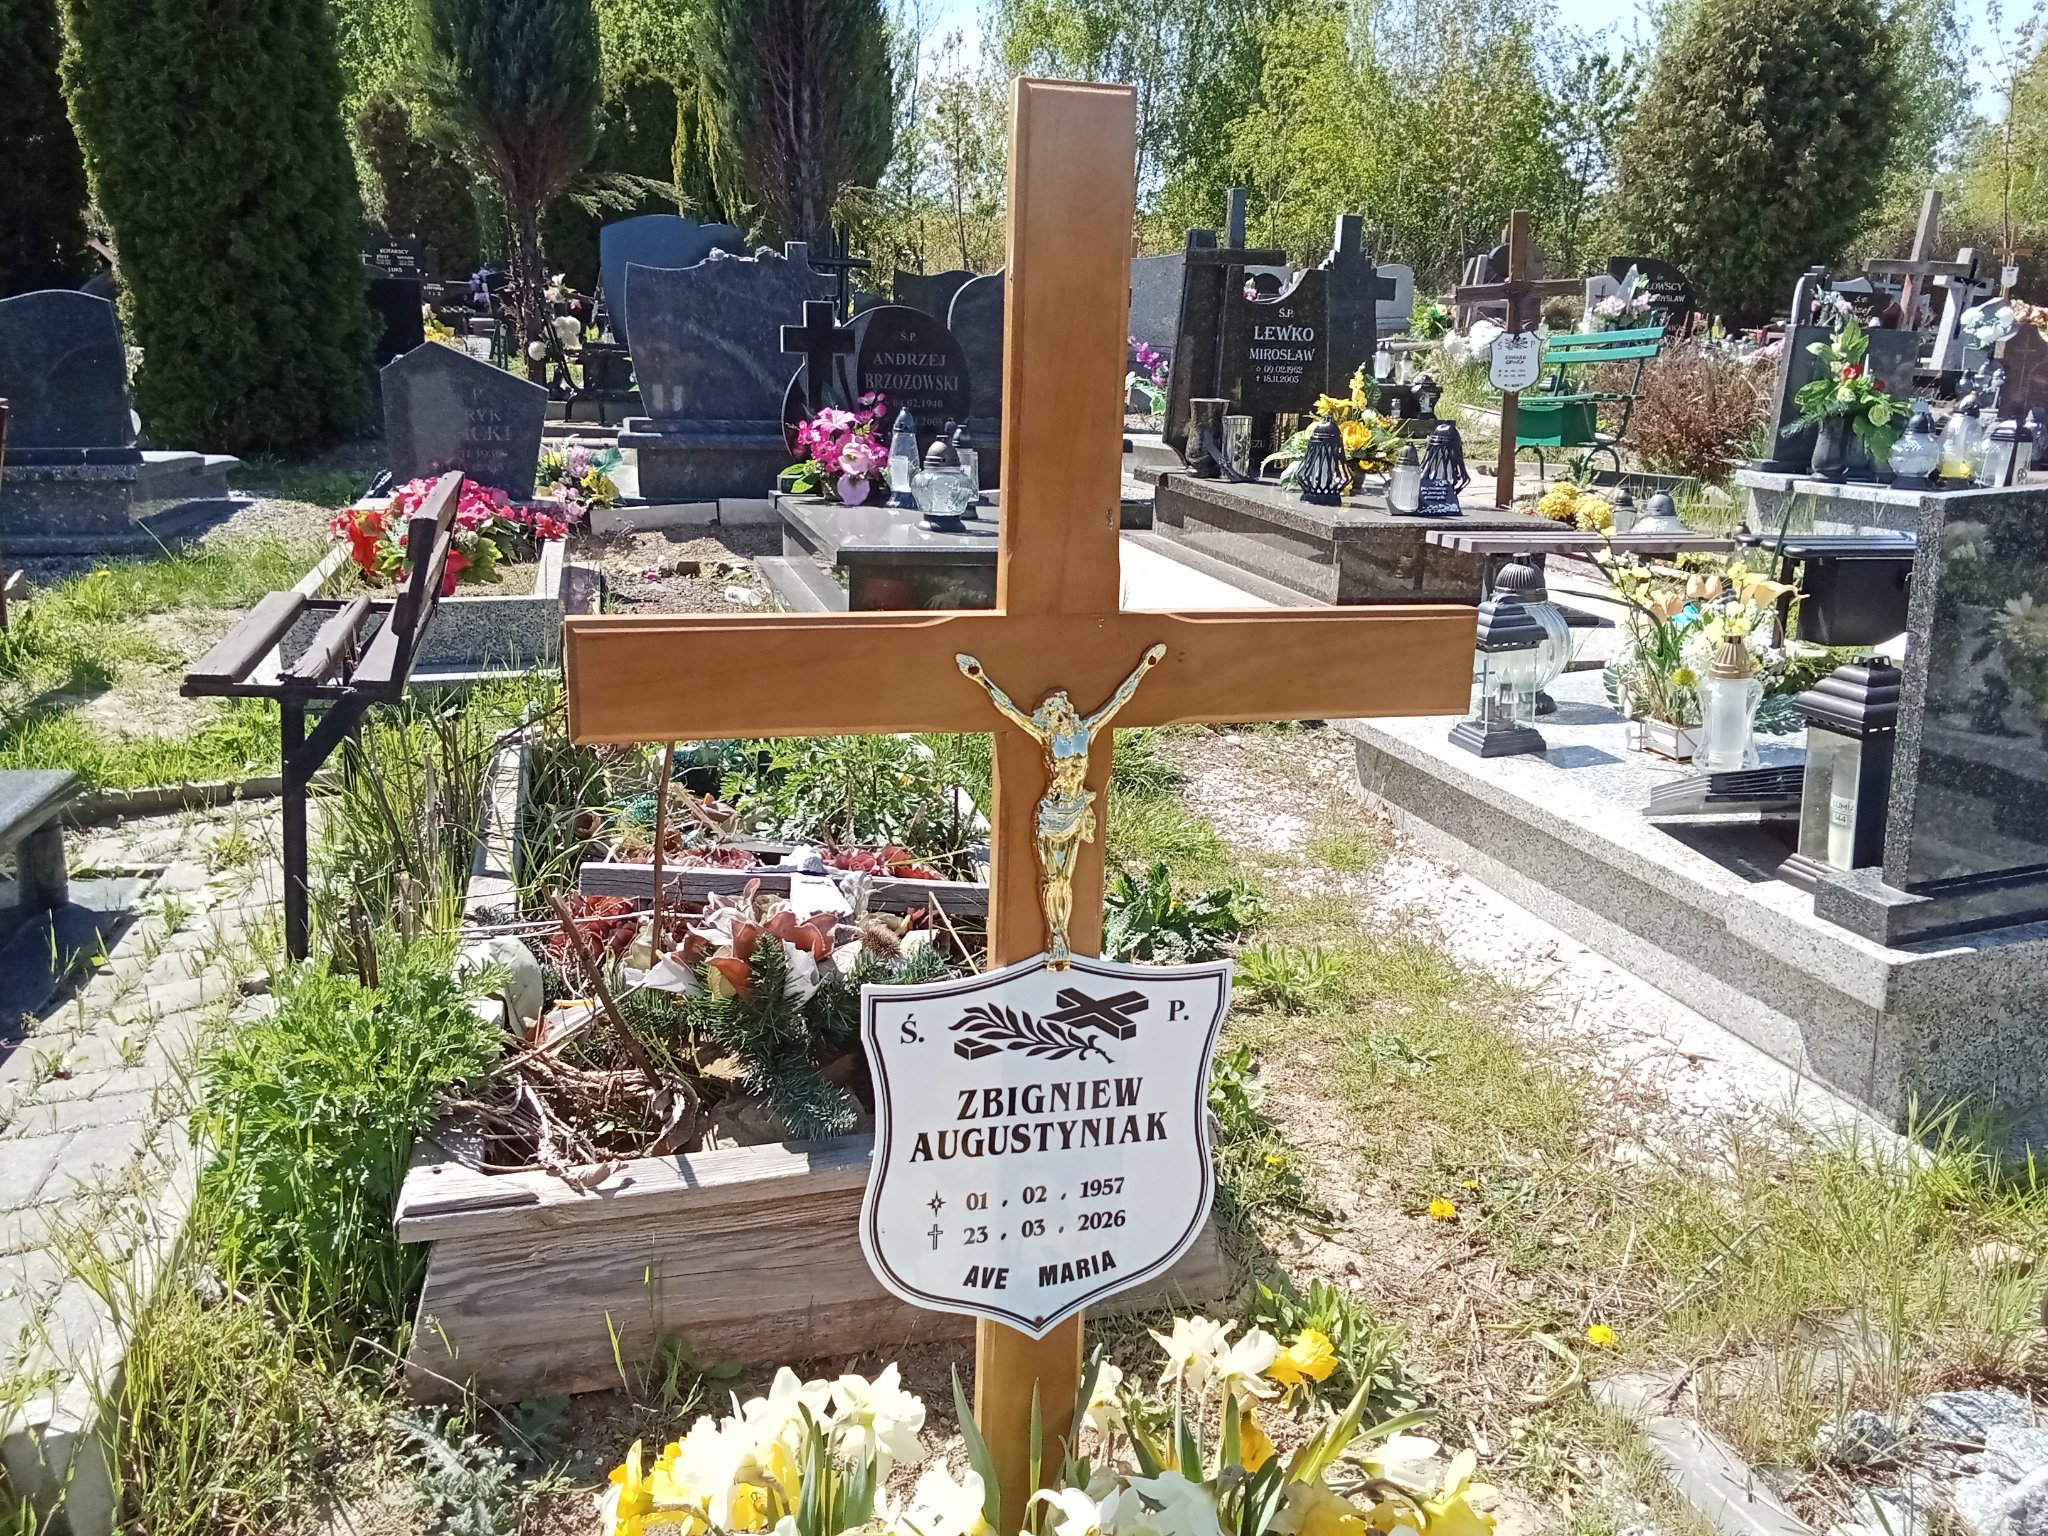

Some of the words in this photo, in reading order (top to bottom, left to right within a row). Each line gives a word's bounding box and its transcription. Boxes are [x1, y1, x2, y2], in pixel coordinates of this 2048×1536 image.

[1253, 324, 1314, 342] LEWKO
[872, 352, 947, 367] ANDRZEJ
[1249, 347, 1316, 362] MIROSŁAW
[865, 373, 959, 391] BRZOZOWSKI
[900, 1013, 925, 1045] Ś.
[1167, 1000, 1190, 1022] P.
[956, 1076, 1144, 1121] ZBIGNIEW
[909, 1110, 1169, 1164] AUGUSTYNIAK
[1079, 1177, 1125, 1198] 1957
[1077, 1209, 1127, 1232] 2026
[962, 1265, 1010, 1290] AVE
[1038, 1249, 1117, 1288] MARIA
